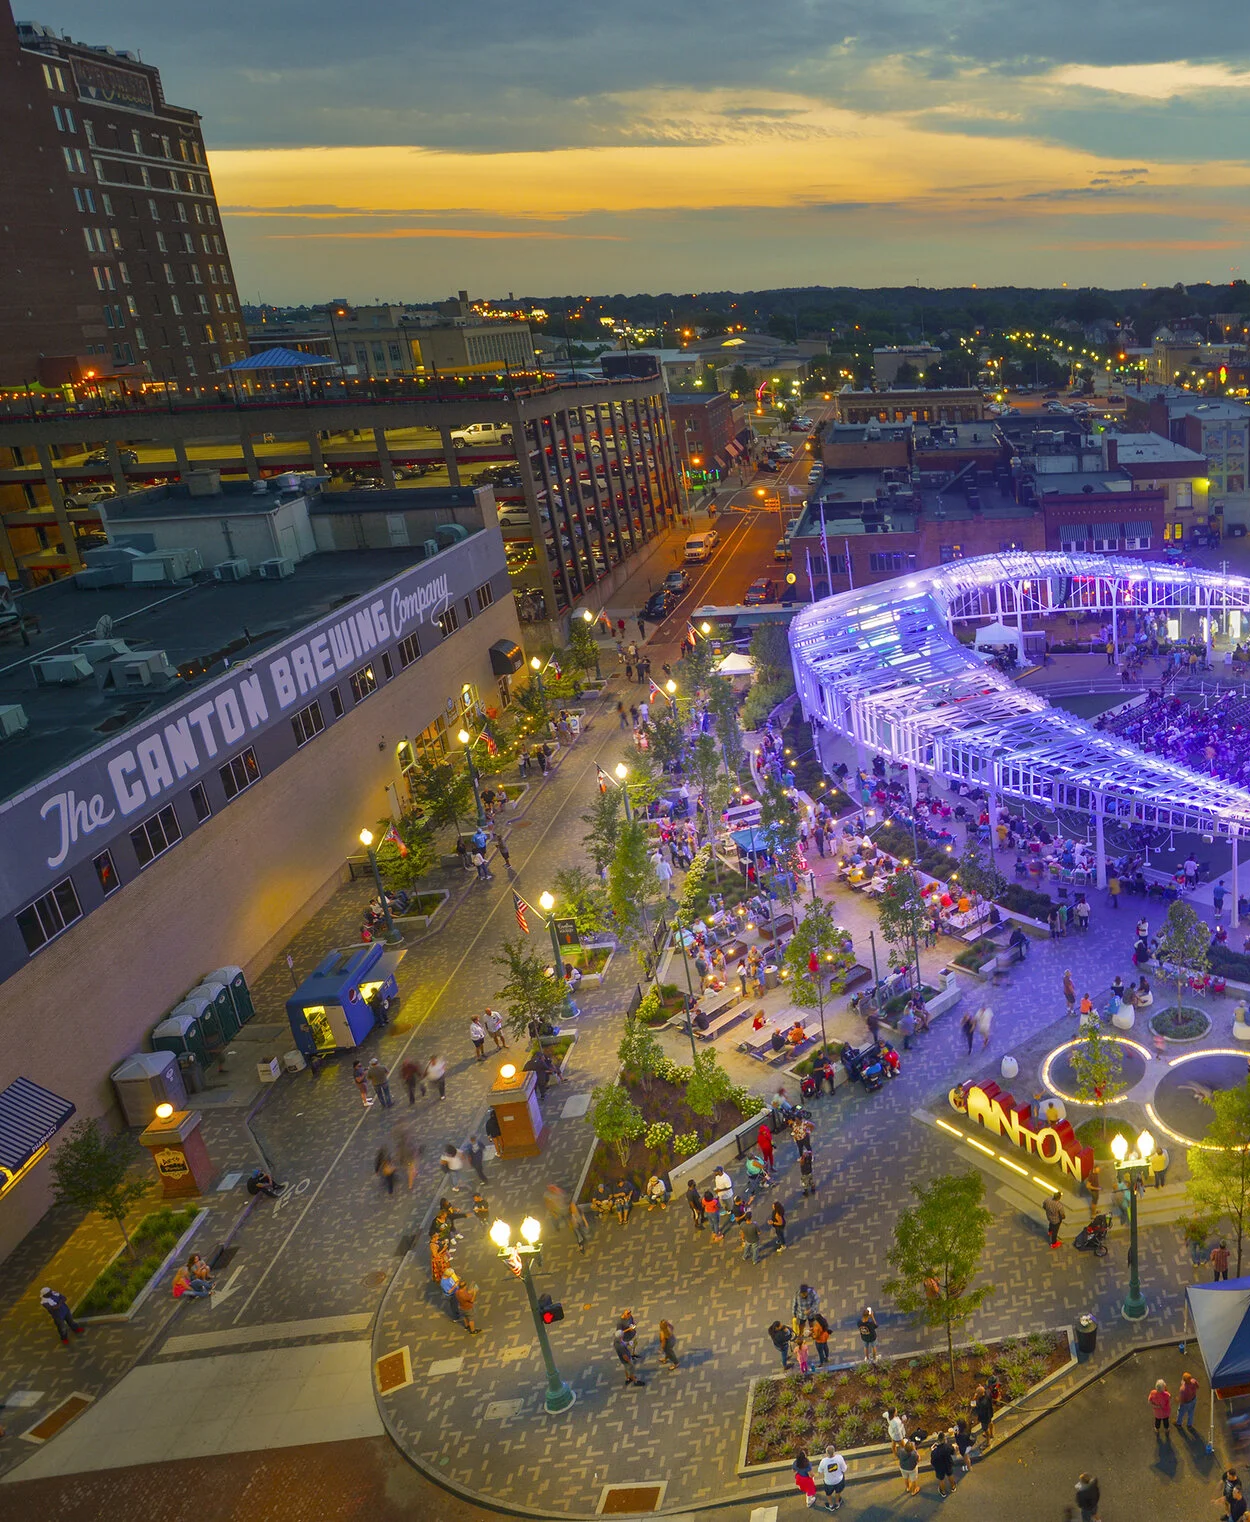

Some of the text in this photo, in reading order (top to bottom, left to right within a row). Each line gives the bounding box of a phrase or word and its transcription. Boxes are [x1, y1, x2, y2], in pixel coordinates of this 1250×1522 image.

[41, 572, 453, 868] The CANTON BREWING Company
[31, 1124, 57, 1152] PHARMACY
[948, 1086, 1082, 1182] CANTON
